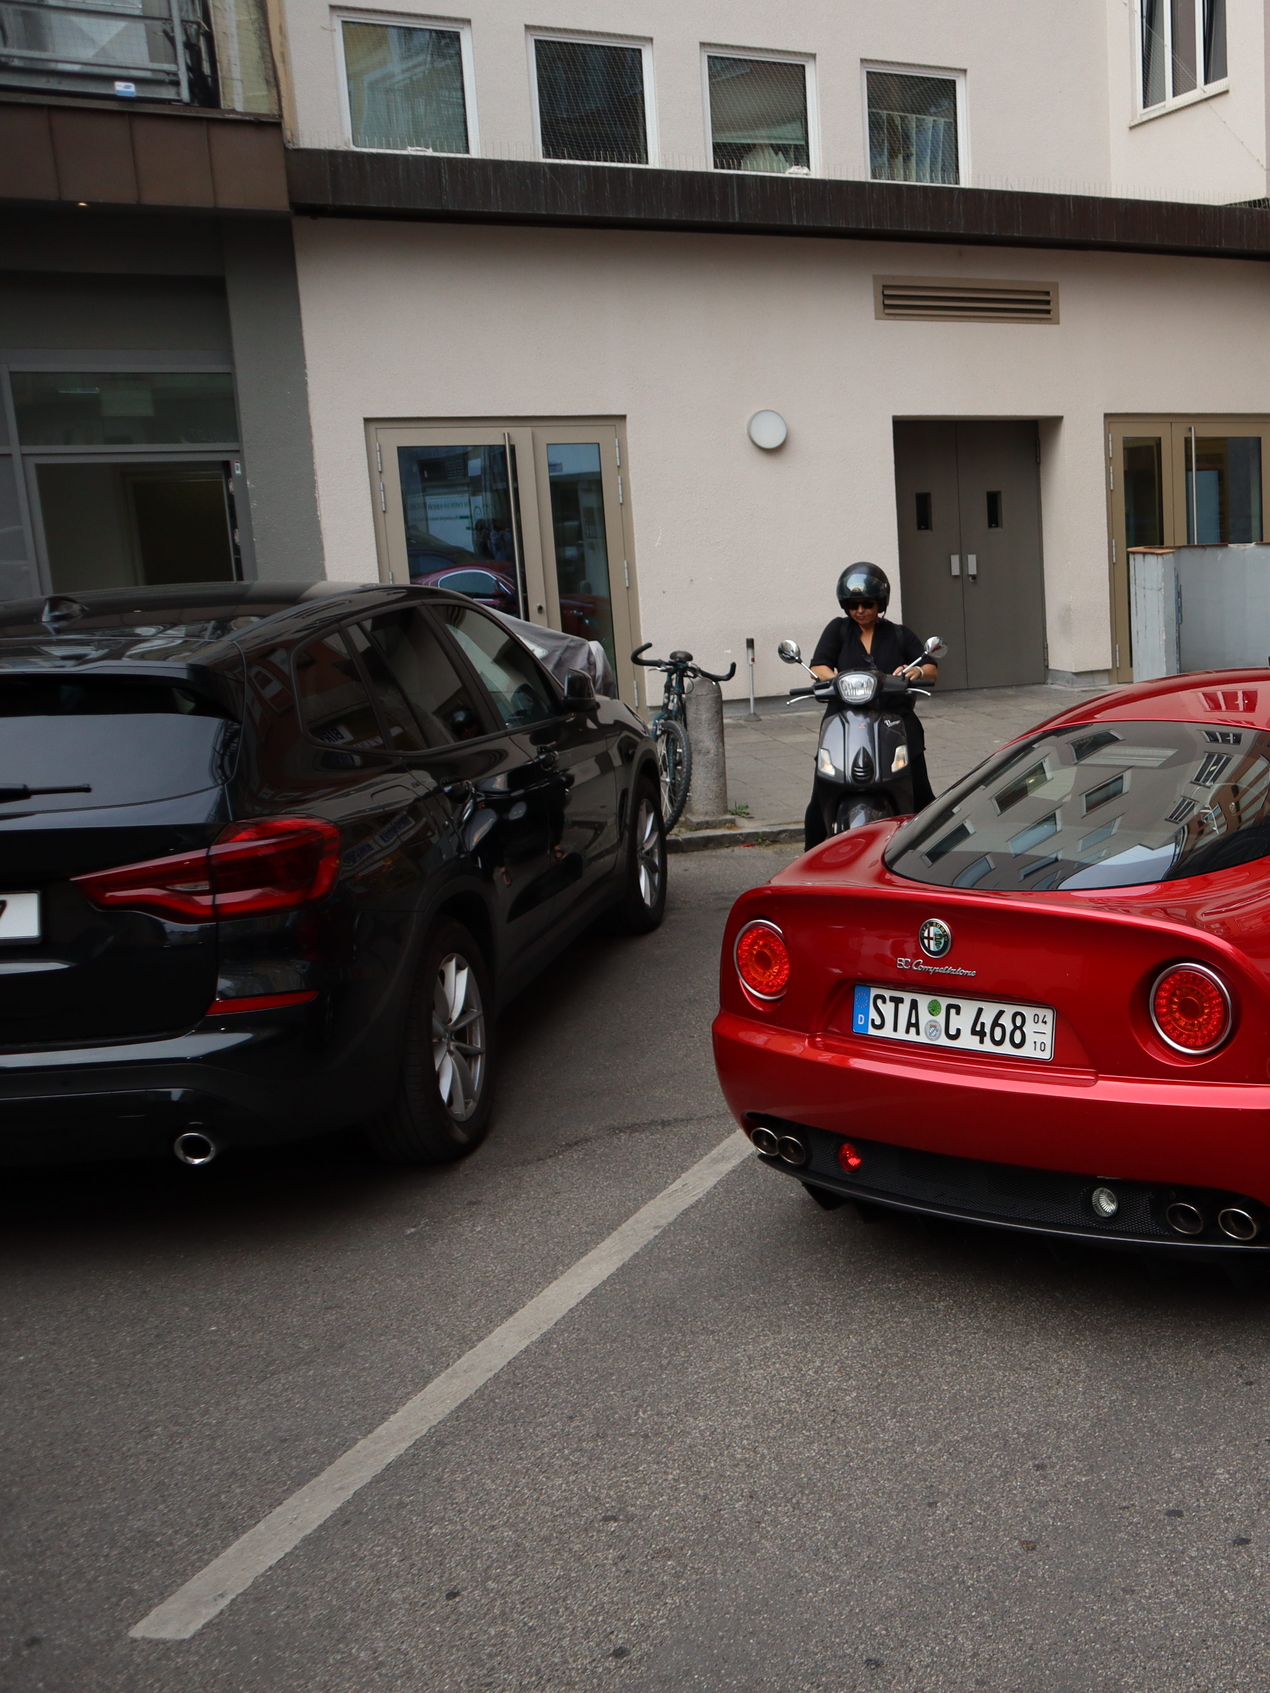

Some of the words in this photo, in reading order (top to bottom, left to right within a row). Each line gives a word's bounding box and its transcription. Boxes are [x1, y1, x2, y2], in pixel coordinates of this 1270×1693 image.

[858, 1014, 865, 1025] D
[870, 993, 921, 1036] STA
[944, 1003, 962, 1041] C
[970, 1006, 1027, 1049] 468
[1033, 1013, 1048, 1025] 04
[1033, 1041, 1046, 1052] 10
